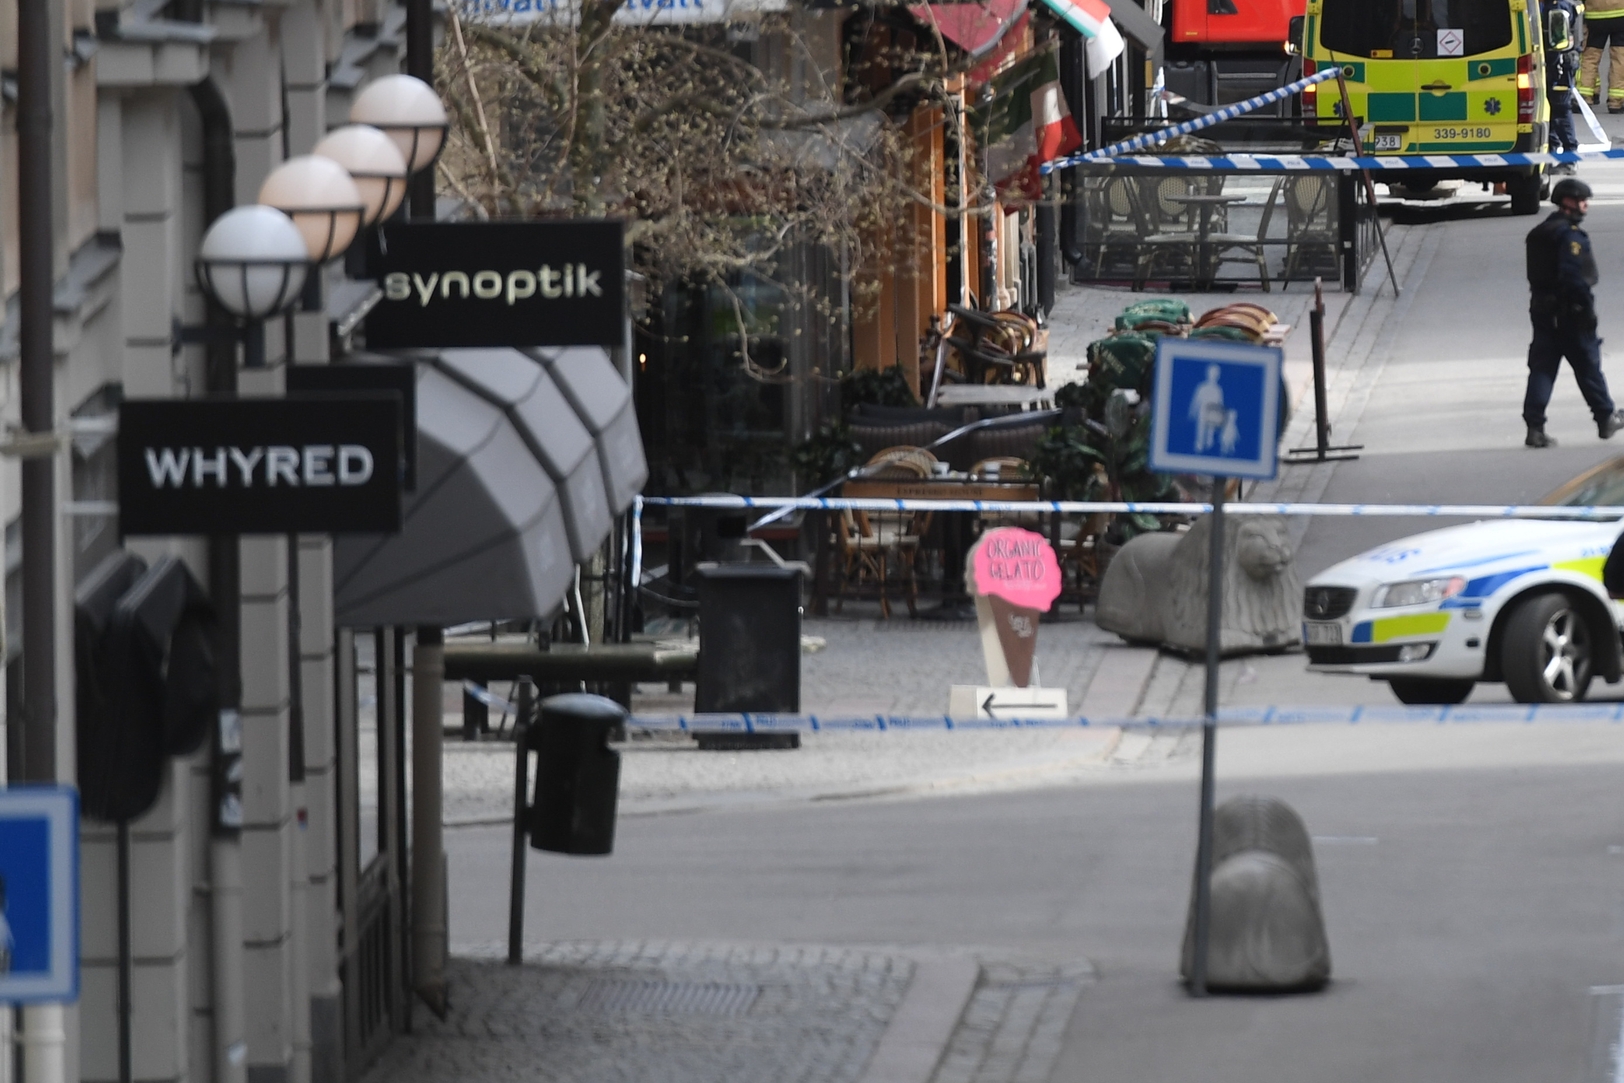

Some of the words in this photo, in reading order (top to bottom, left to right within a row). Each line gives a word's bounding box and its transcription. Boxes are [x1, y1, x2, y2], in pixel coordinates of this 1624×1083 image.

[1434, 127, 1492, 140] 339-9180
[382, 262, 604, 307] synoptik
[144, 443, 376, 488] WHYRED
[986, 539, 1043, 558] ORGANIC
[989, 561, 1045, 581] GELATO
